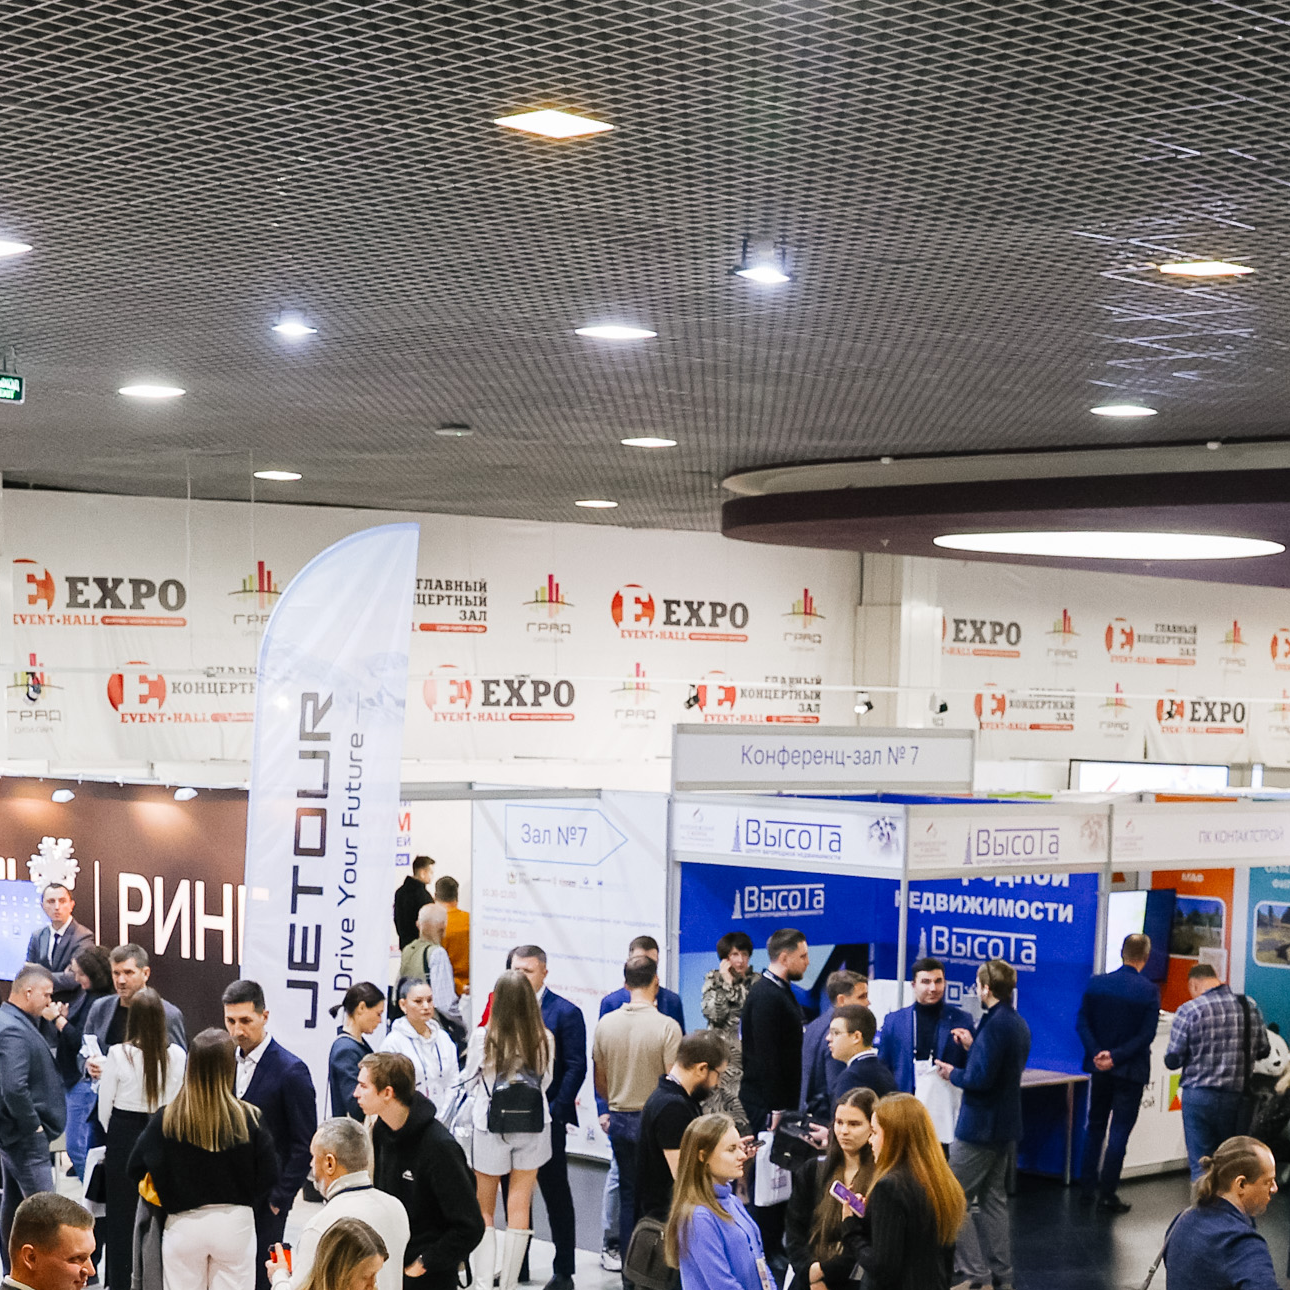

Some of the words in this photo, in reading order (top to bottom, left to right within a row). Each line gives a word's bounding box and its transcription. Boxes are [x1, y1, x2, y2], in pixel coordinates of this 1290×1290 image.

[65, 576, 187, 611] EXPO
[415, 578, 487, 593] ГЛАВНЫЙ
[414, 593, 487, 607] ЦЕРТНЫЙ
[459, 610, 487, 621] ЗАЛ
[663, 599, 749, 629] EXPO
[526, 623, 571, 634] ГРАД
[952, 618, 1022, 646] EXPO
[481, 679, 575, 708] EXPO
[1189, 700, 1246, 723] EXPO
[741, 744, 882, 769] Конференц-зал
[910, 746, 920, 765] 7
[342, 732, 364, 828] Future
[521, 823, 551, 845] Зал
[1214, 826, 1284, 843] КОНТАКТСТРОЙ
[286, 691, 334, 1029] JETOUR
[338, 838, 358, 907] Your
[333, 917, 356, 992] Drive
